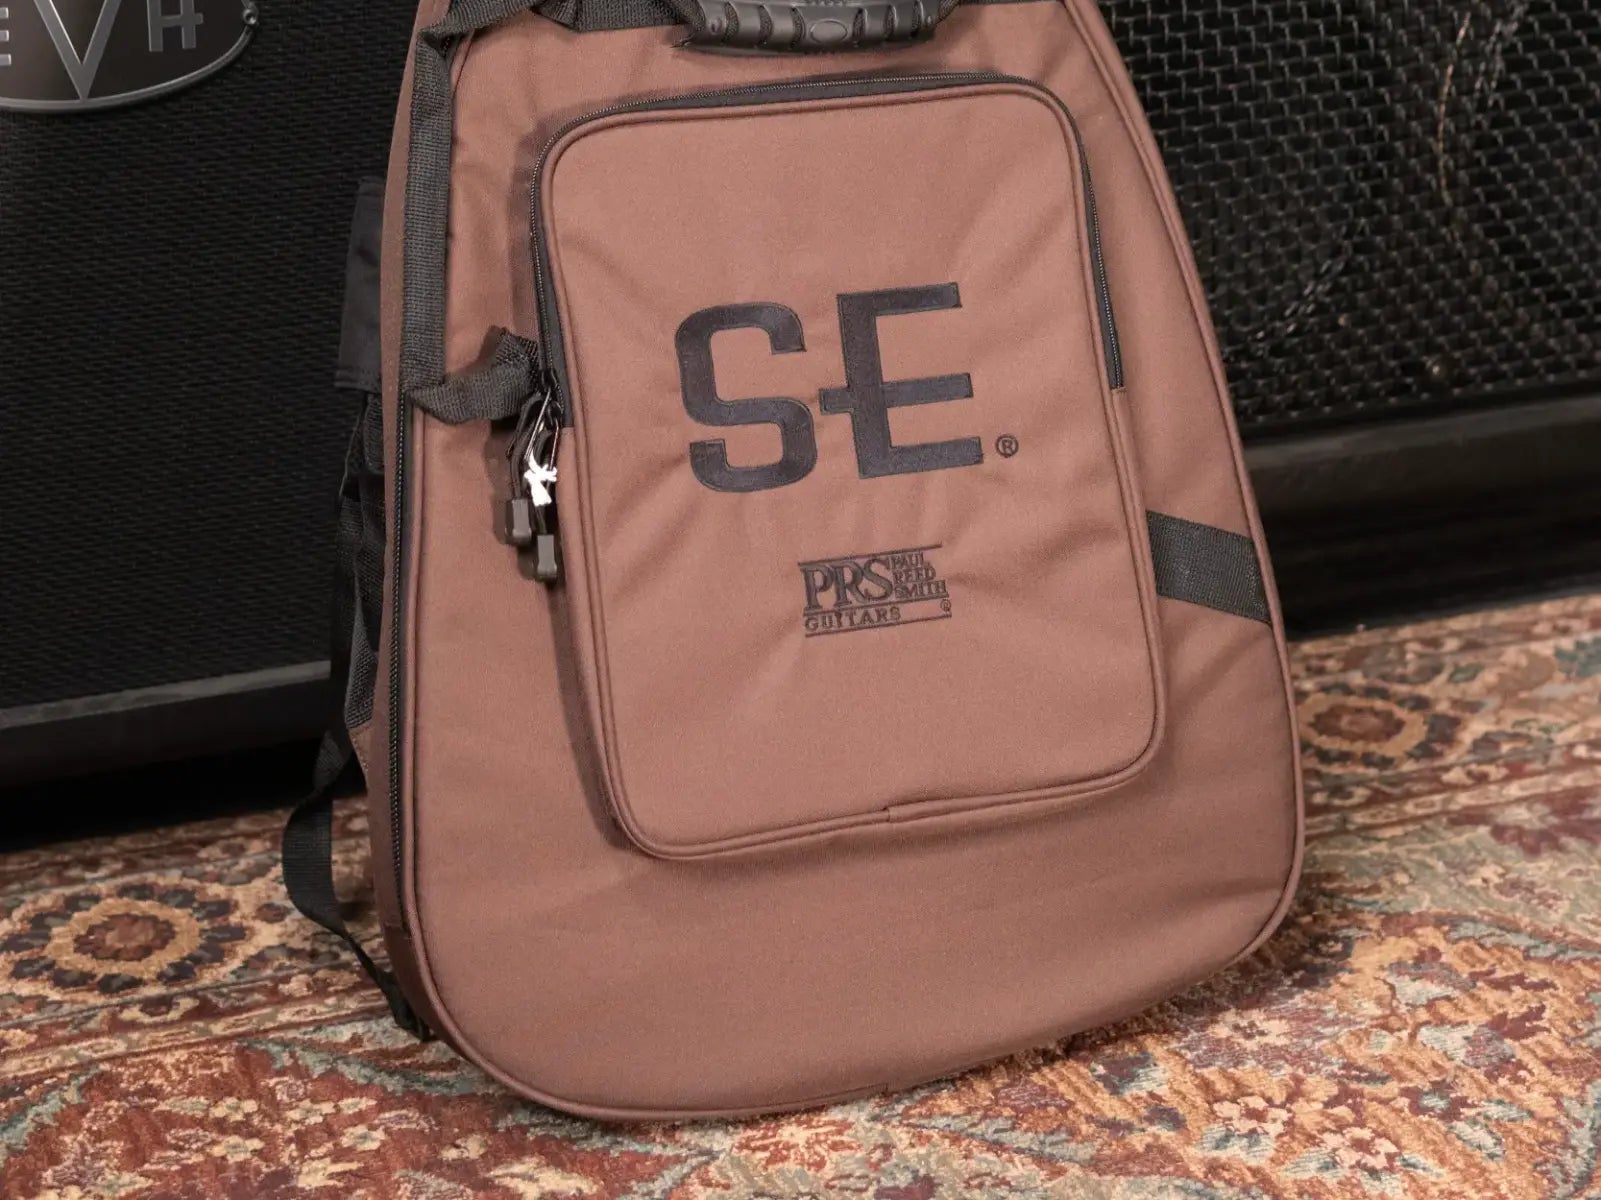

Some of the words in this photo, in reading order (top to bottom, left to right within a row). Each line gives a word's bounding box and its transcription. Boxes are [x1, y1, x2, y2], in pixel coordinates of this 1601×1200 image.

[674, 282, 984, 492] SE
[891, 551, 927, 569] PAUL
[801, 558, 893, 611] PRS
[893, 564, 936, 584] REED
[894, 580, 946, 599] SMITH
[805, 606, 901, 632] GUITARS
